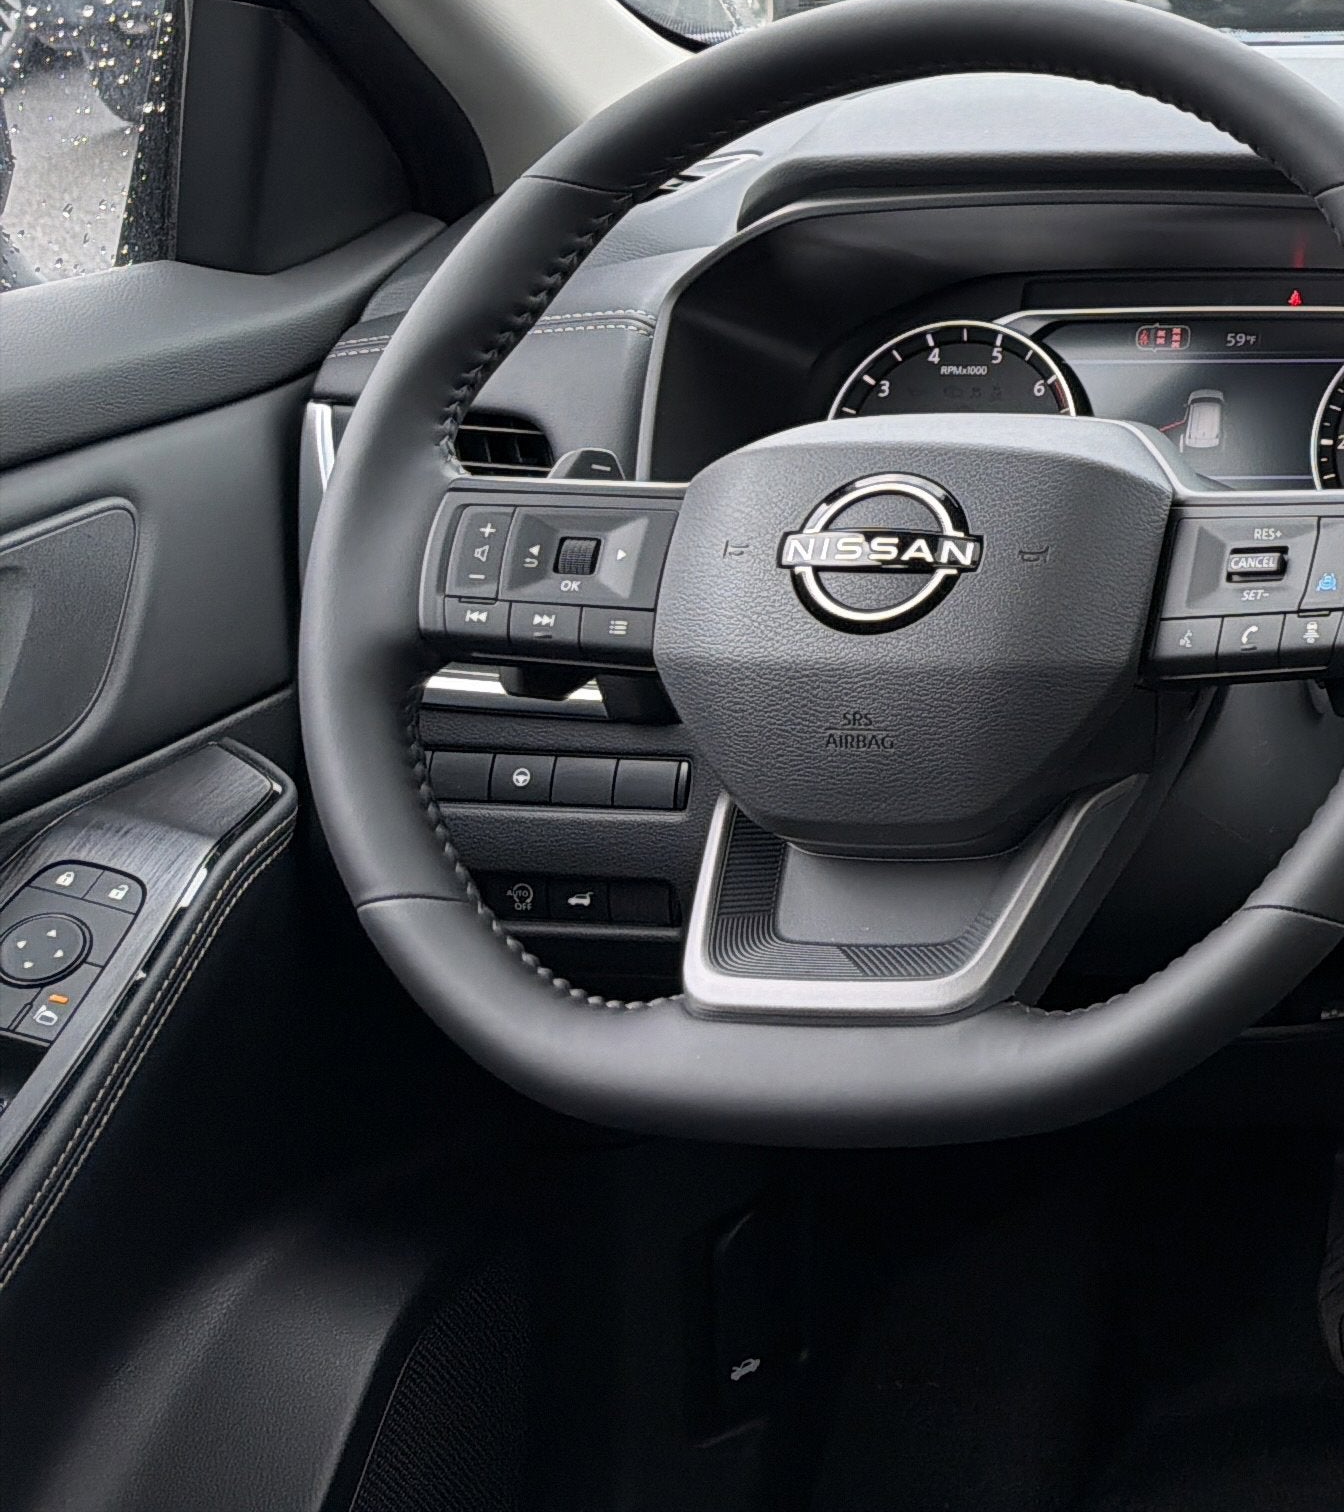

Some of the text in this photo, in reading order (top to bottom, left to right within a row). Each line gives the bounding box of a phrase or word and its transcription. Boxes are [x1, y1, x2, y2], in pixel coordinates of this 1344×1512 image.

[1226, 333, 1256, 347] 59°F
[928, 348, 941, 364] 4
[991, 348, 1003, 364] 5
[940, 366, 988, 376] RPMx1000
[878, 381, 890, 397] 3
[1033, 380, 1045, 396] 6
[785, 533, 975, 566] NISSAN
[1231, 556, 1276, 570] CANCEL
[560, 580, 580, 592] OK
[842, 711, 872, 726] SRS
[826, 733, 894, 749] AIRBAG
